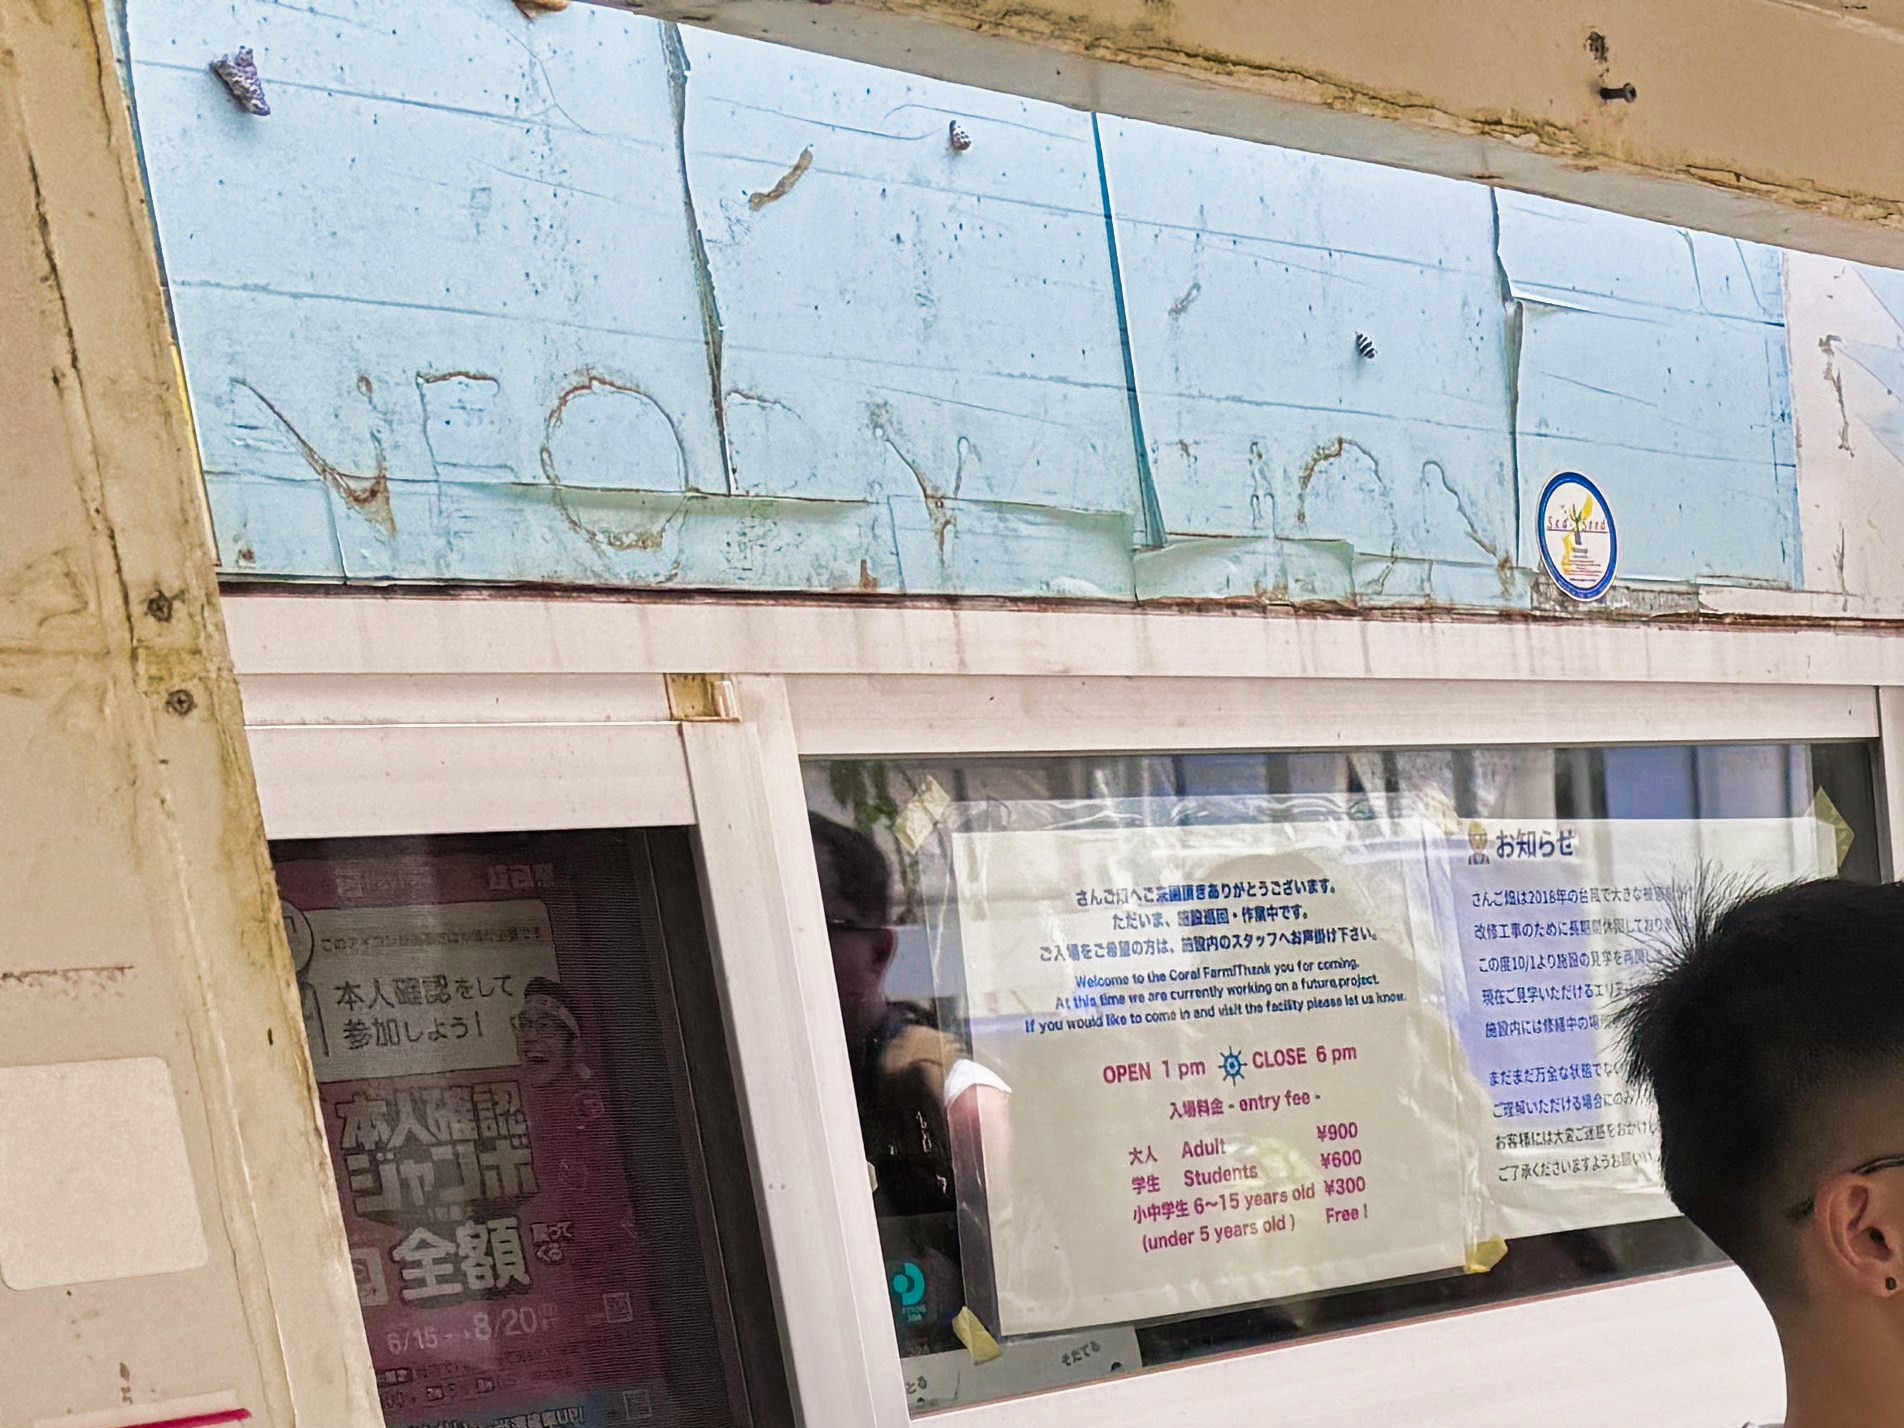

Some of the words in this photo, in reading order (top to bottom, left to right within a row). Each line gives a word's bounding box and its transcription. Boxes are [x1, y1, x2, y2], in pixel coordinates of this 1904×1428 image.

[1496, 829, 1574, 859] お知らせ
[1055, 996, 1071, 1011] At
[1072, 994, 1098, 1010] this
[1099, 992, 1126, 1007] time
[1127, 993, 1146, 1004] we
[1147, 991, 1168, 1003] are
[1169, 985, 1224, 1001] currently
[1226, 981, 1273, 996] working
[1274, 982, 1290, 993] on
[1291, 980, 1299, 991] a
[1300, 977, 1336, 990] future
[1334, 973, 1380, 989] project.
[1074, 974, 1130, 989] Welcome
[1131, 973, 1145, 985] to
[1146, 971, 1167, 984] the
[1168, 967, 1201, 982] Coral
[1202, 962, 1271, 979] Farm!Thank
[1273, 963, 1295, 977] you
[1296, 959, 1315, 972] for
[1317, 957, 1360, 971] coming.
[1025, 1018, 1035, 1034] If
[1038, 1020, 1064, 1035] you
[1065, 1015, 1104, 1031] would
[1105, 1013, 1128, 1027] like
[1129, 1012, 1143, 1024] to
[1144, 1010, 1177, 1024] come
[1179, 1007, 1191, 1021] in
[1193, 1004, 1216, 1019] and
[1217, 1003, 1243, 1017] visit
[1244, 1002, 1264, 1015] the
[1265, 998, 1304, 1013] facility
[1306, 996, 1343, 1012] please
[1344, 994, 1360, 1007] let
[1361, 994, 1375, 1005] us
[1375, 991, 1407, 1004] know.
[1102, 1061, 1152, 1084] OPEN
[1161, 1059, 1170, 1079] 1
[1177, 1060, 1206, 1081] pm
[1252, 1046, 1308, 1069] CLOSE
[1315, 1045, 1327, 1063] 6
[1331, 1046, 1358, 1066] pm
[1169, 1097, 1225, 1121] 入場料金
[1239, 1094, 1281, 1112] entry
[1284, 1089, 1311, 1107] fee
[1128, 1144, 1158, 1167] 大人
[1181, 1137, 1226, 1159] Adult
[1316, 1121, 1359, 1142] ¥900
[1131, 1173, 1161, 1196] 学生
[1183, 1163, 1258, 1188] Students
[1320, 1148, 1362, 1170] ¥600
[1133, 1199, 1190, 1225] 小中学生
[1243, 1190, 1289, 1211] years
[1291, 1182, 1316, 1202] old
[1323, 1175, 1366, 1197] ¥300
[1142, 1229, 1195, 1254] (under
[1199, 1225, 1210, 1243] 5
[1213, 1222, 1259, 1244] years
[1262, 1214, 1287, 1234] old
[1325, 1207, 1360, 1224] Free
[392, 1214, 532, 1303] 全額
